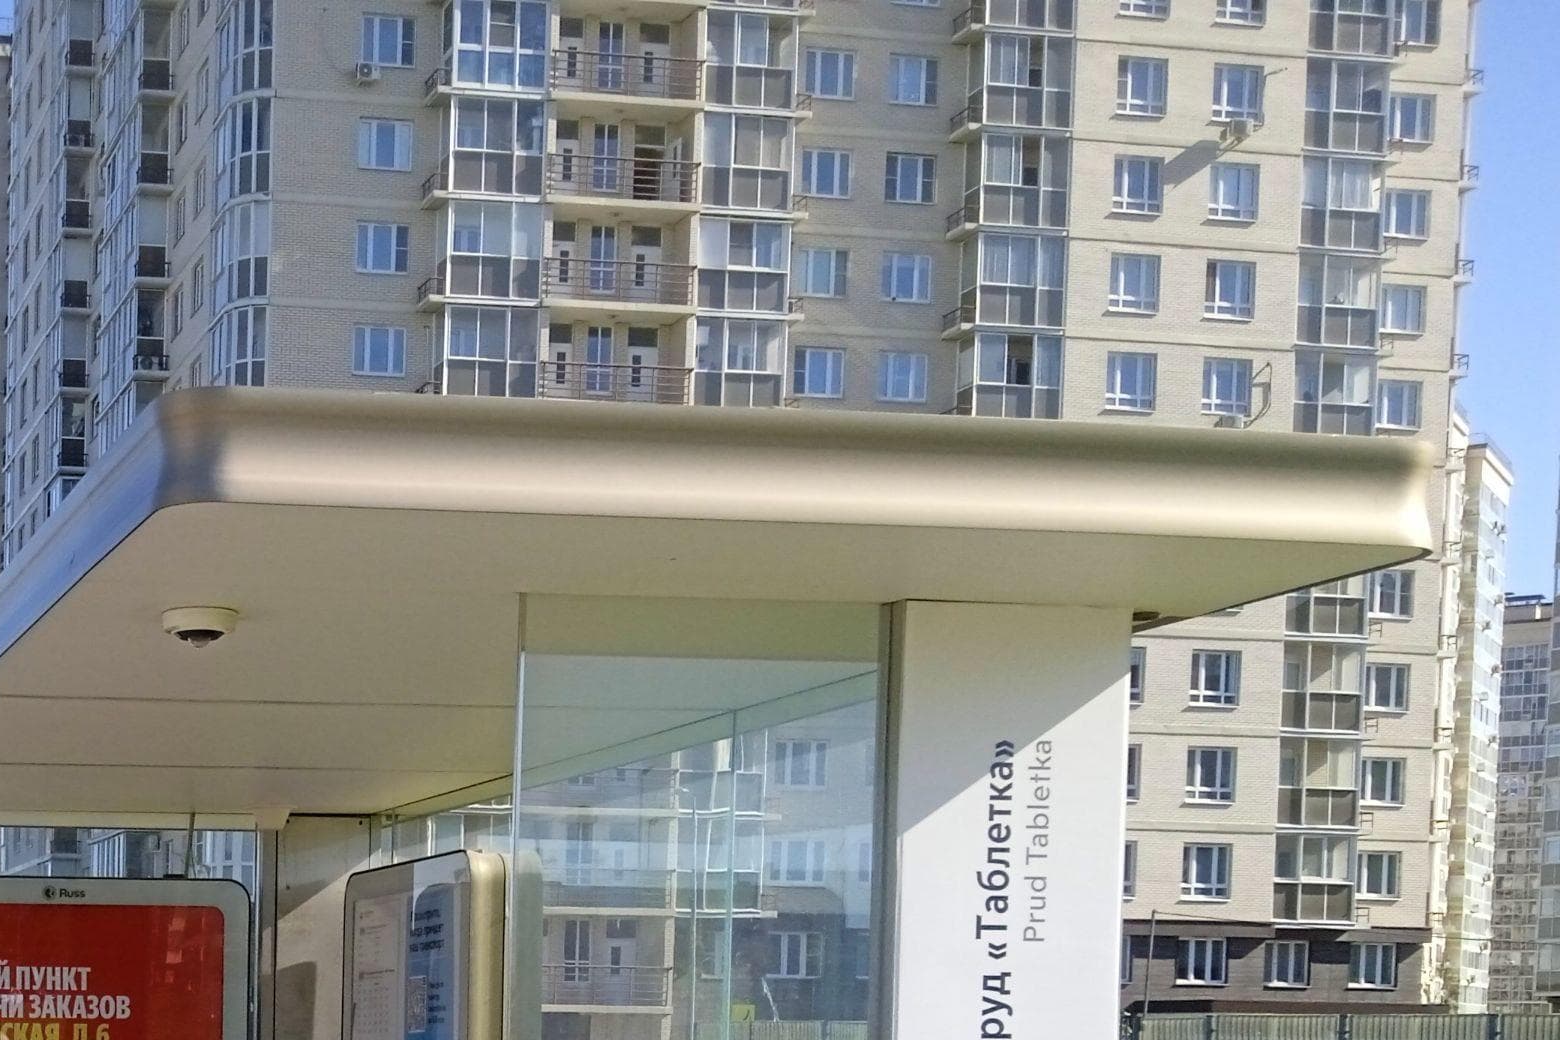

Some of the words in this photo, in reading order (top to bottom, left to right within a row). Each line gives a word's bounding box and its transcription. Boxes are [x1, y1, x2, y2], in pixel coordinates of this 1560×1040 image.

[1025, 739, 1053, 866] Tabletka
[975, 739, 1015, 961] «Таблетка»
[59, 888, 86, 898] Russ
[1022, 875, 1048, 942] Prud
[15, 966, 91, 991] ПУНКТ
[28, 995, 131, 1019] ЗАКАЗОВ
